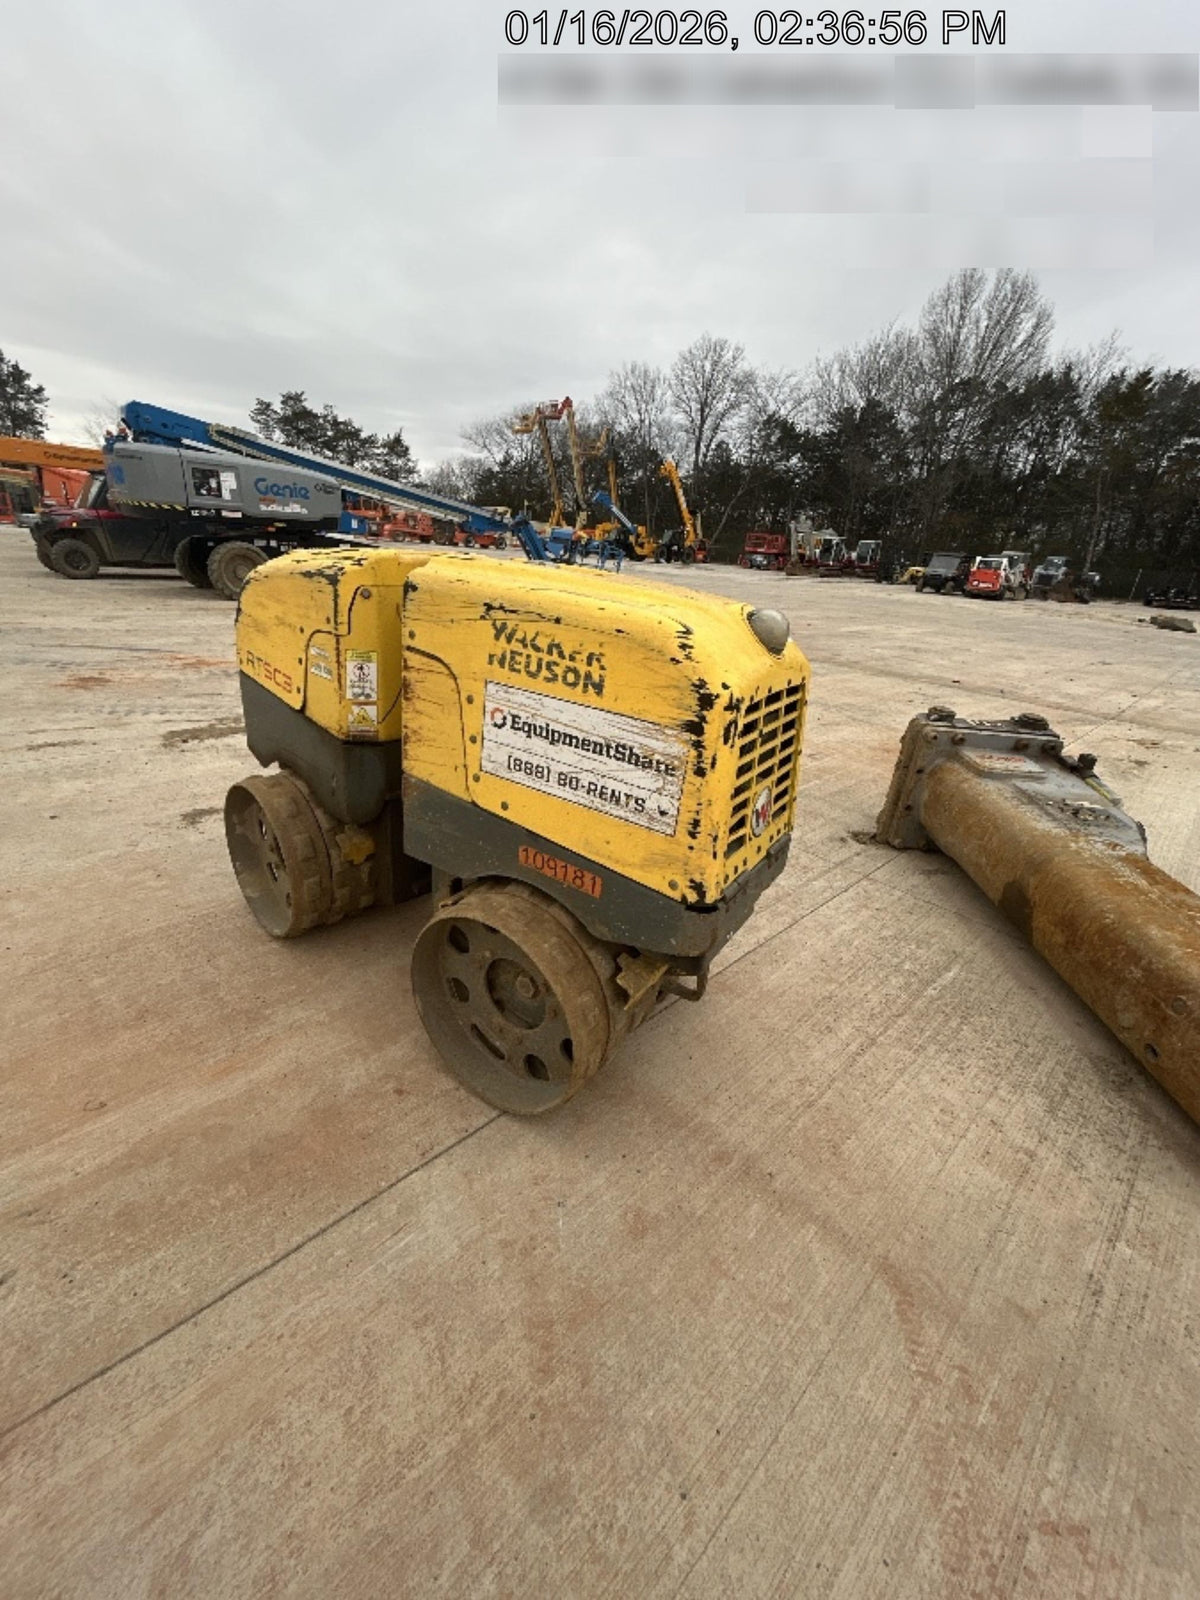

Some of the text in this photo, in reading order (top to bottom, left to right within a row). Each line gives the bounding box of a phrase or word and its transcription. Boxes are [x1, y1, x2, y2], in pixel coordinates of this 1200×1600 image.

[254, 477, 310, 500] Genie
[487, 649, 606, 698] NEUSON
[509, 711, 677, 777] EquipmentShare
[522, 847, 597, 895] 109181
